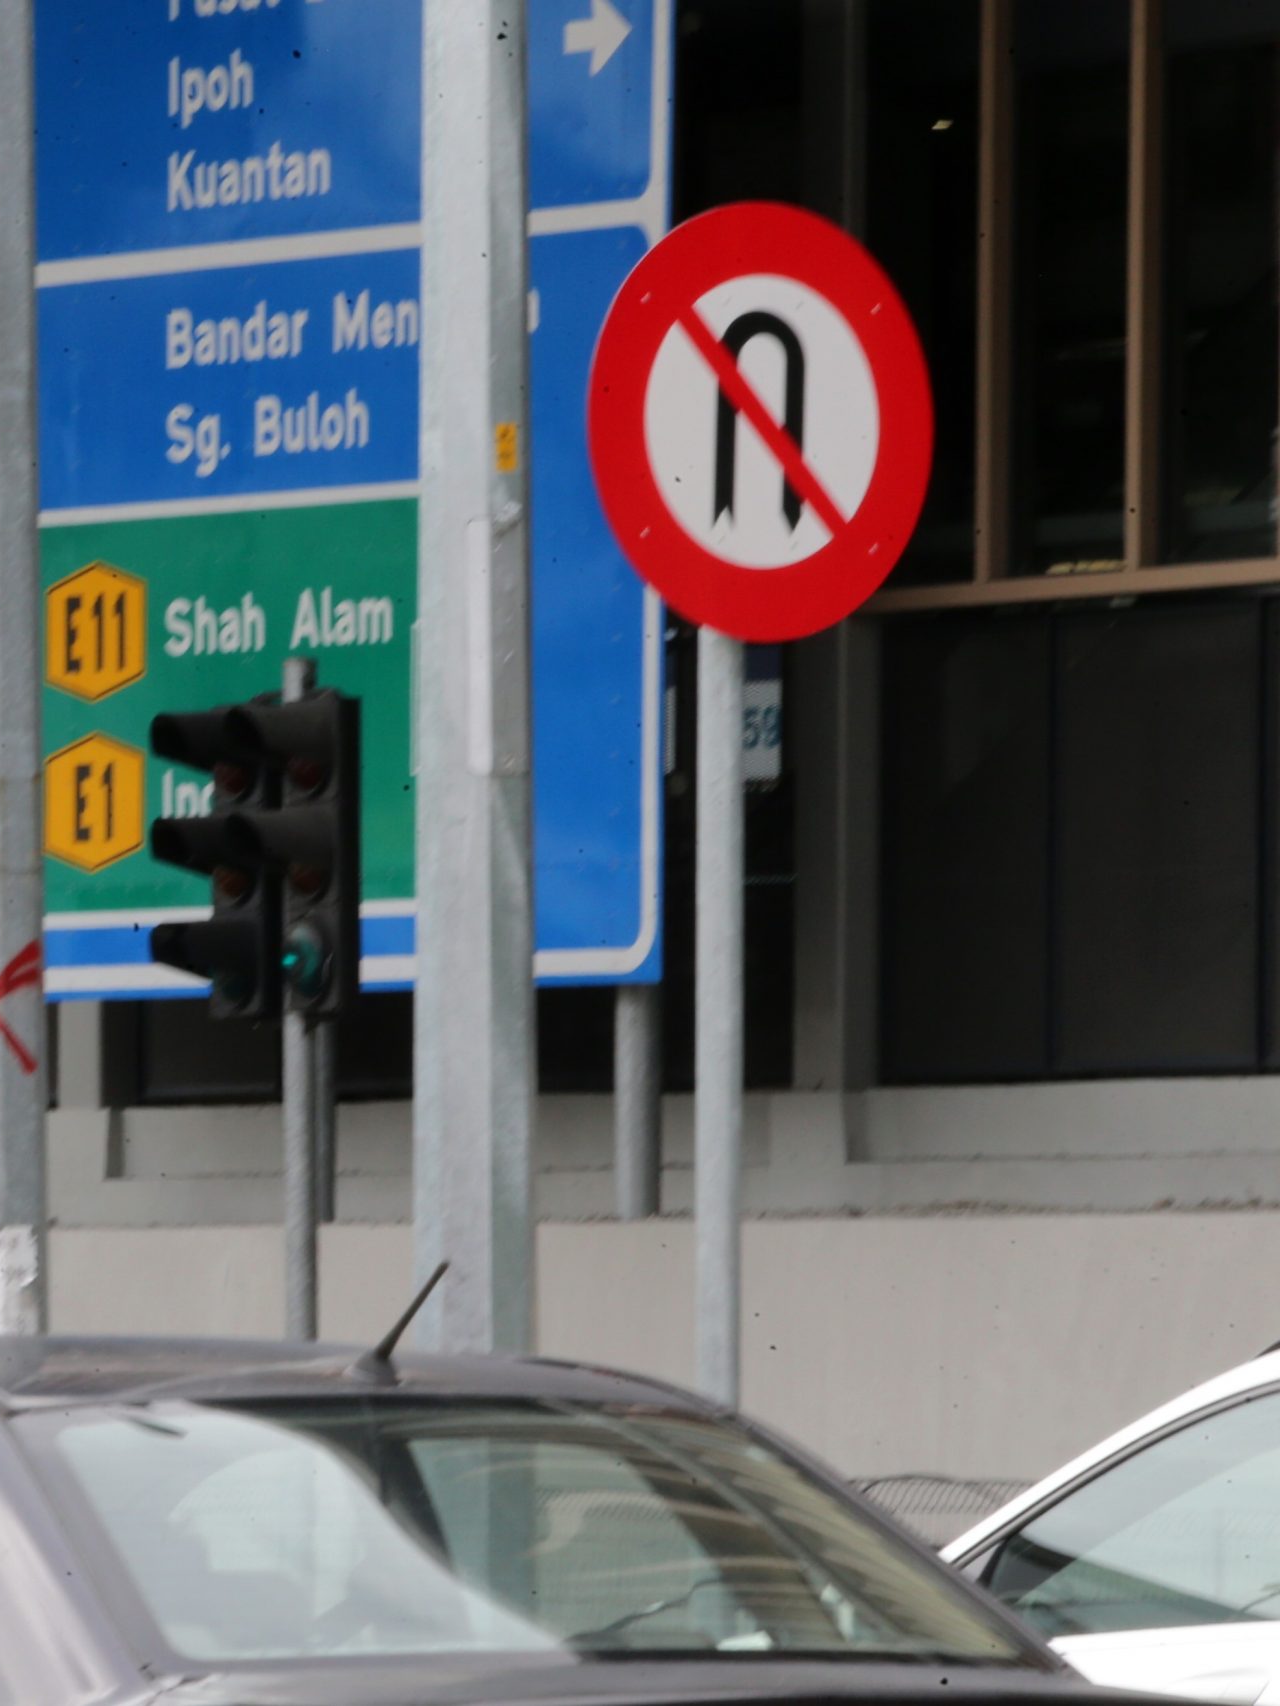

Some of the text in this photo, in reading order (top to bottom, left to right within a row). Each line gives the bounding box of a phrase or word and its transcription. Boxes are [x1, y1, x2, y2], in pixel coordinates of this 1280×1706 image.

[168, 48, 253, 129] Ipoh
[167, 140, 331, 212] Kuantan
[166, 301, 307, 369] Bandar
[165, 388, 368, 477] Sg. Buloh
[65, 593, 125, 673] E11
[164, 587, 394, 657] Shah Alam
[74, 762, 113, 842] E1
